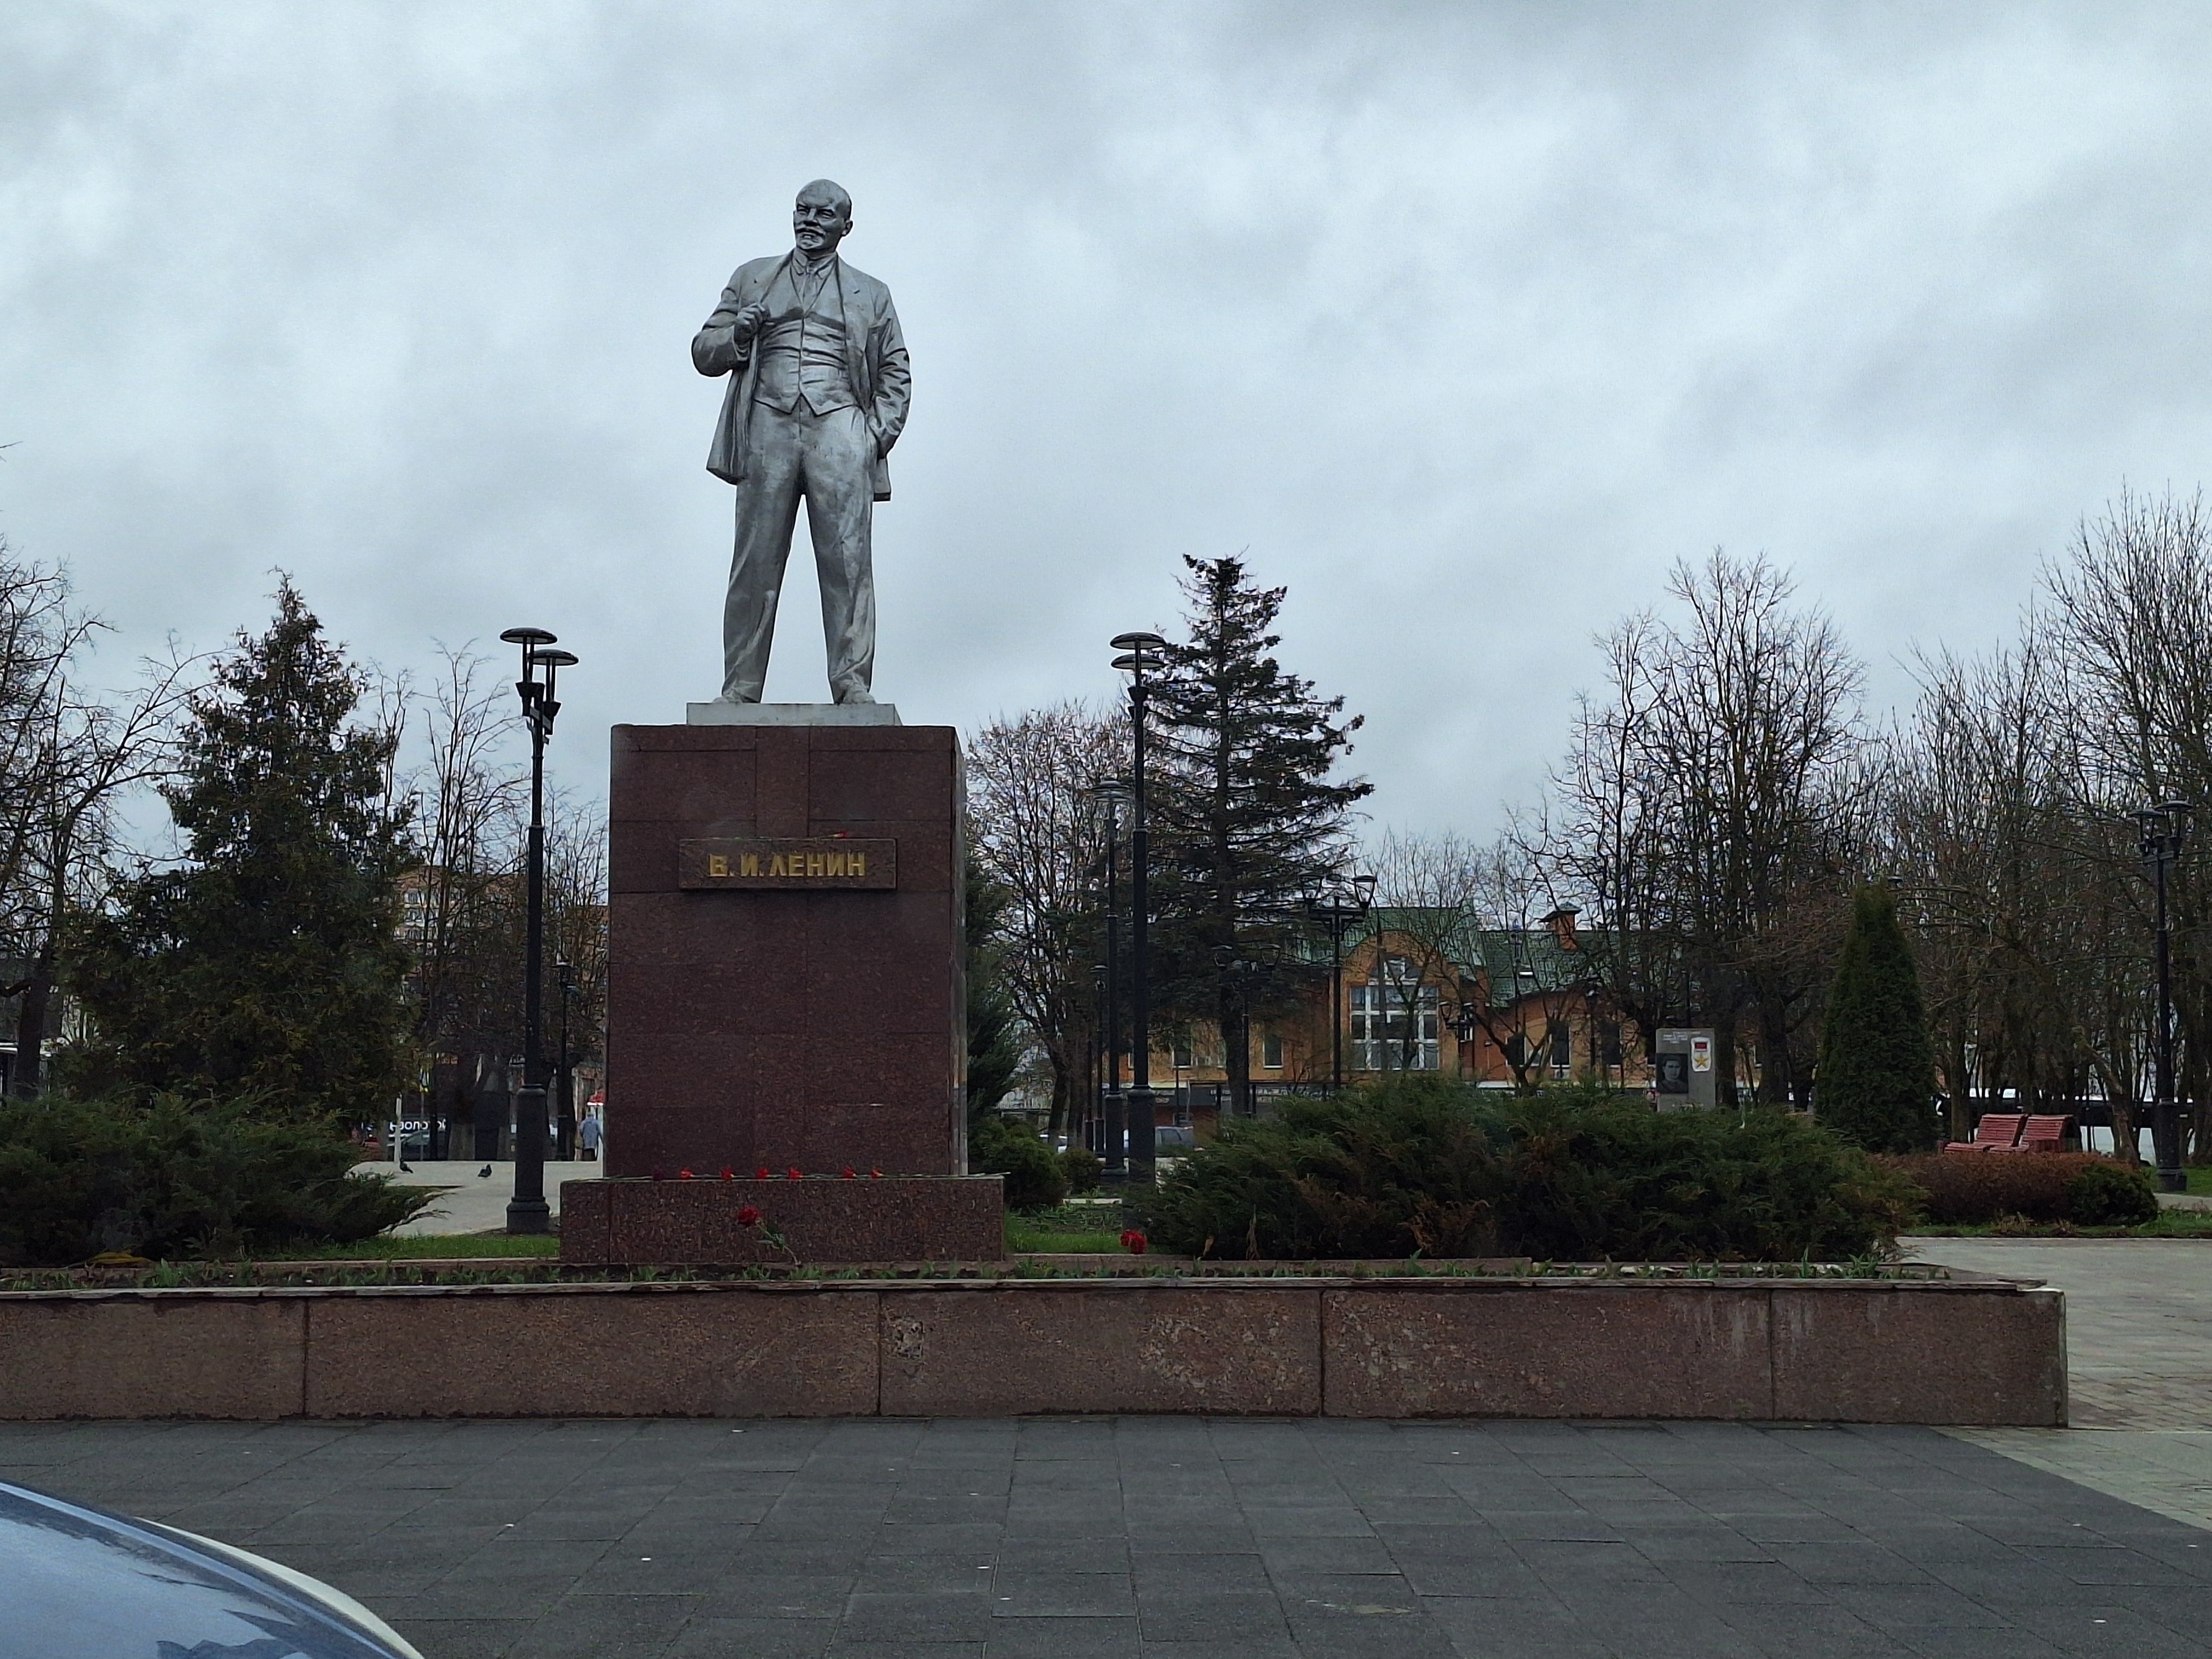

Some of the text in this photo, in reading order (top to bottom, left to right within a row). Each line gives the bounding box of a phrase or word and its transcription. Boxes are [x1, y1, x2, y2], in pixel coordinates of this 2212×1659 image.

[709, 852, 865, 877] В. И. ЛЕНИН
